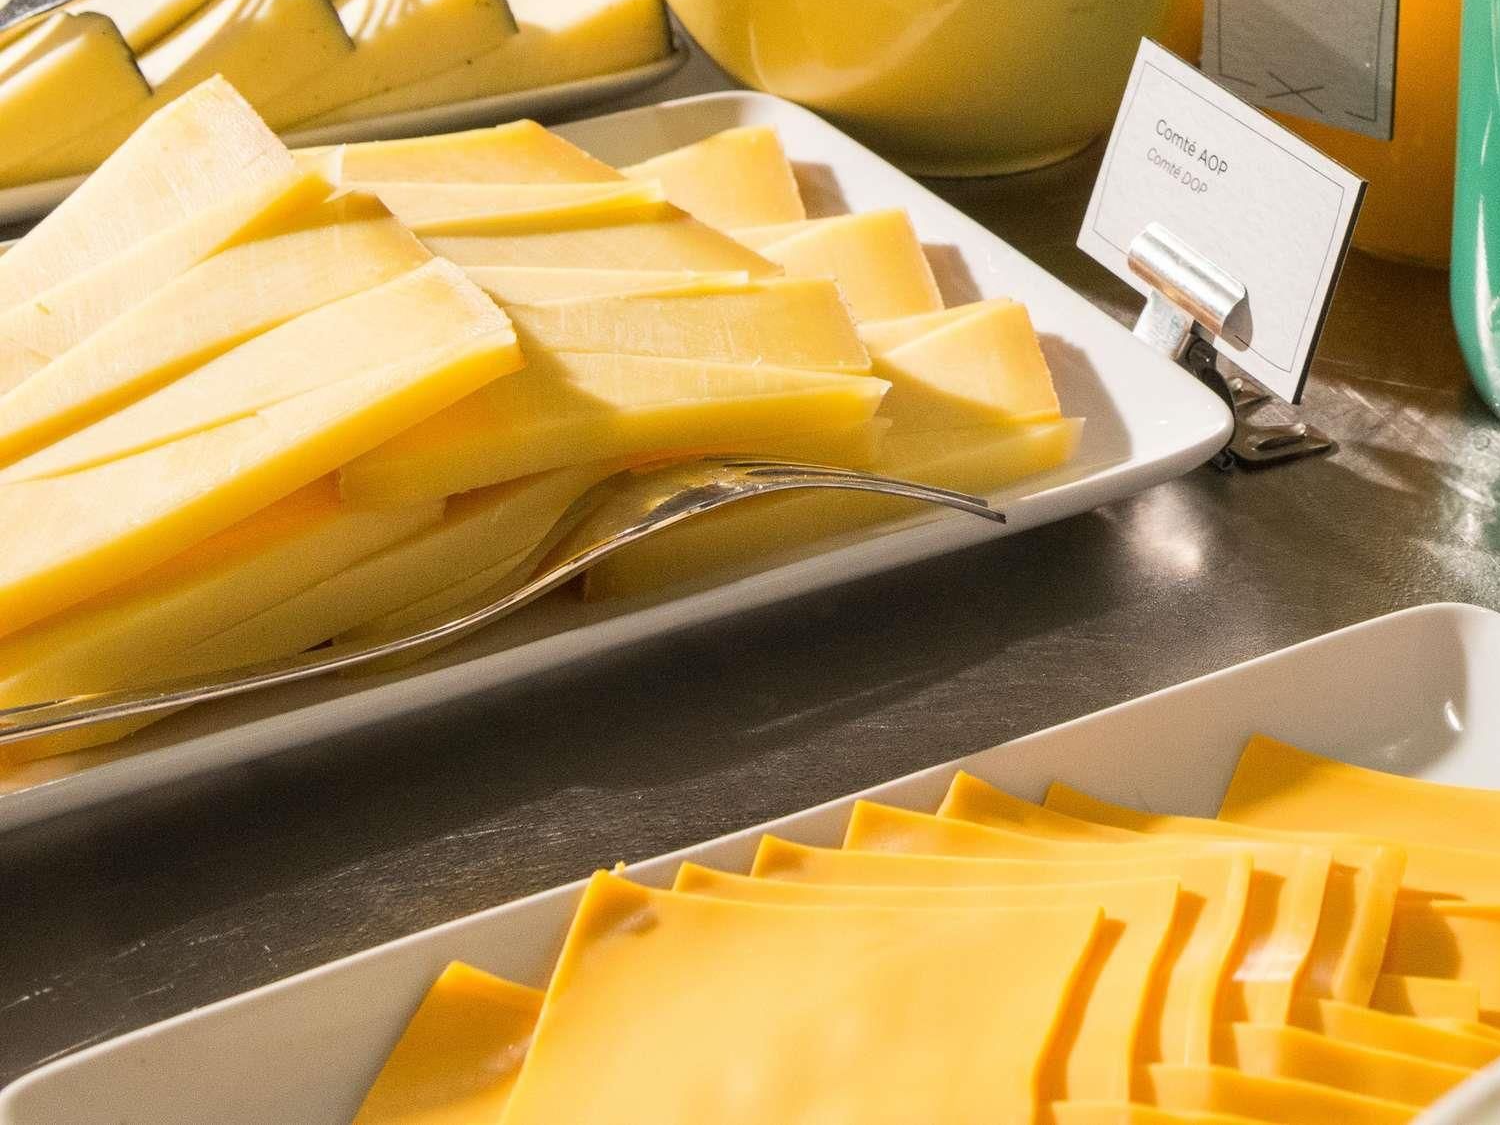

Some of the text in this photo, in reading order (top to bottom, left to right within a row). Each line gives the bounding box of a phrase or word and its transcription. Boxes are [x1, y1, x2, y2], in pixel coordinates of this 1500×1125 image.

[1147, 147, 1208, 194] Comté DOP
[1156, 119, 1228, 175] Comté AOP
